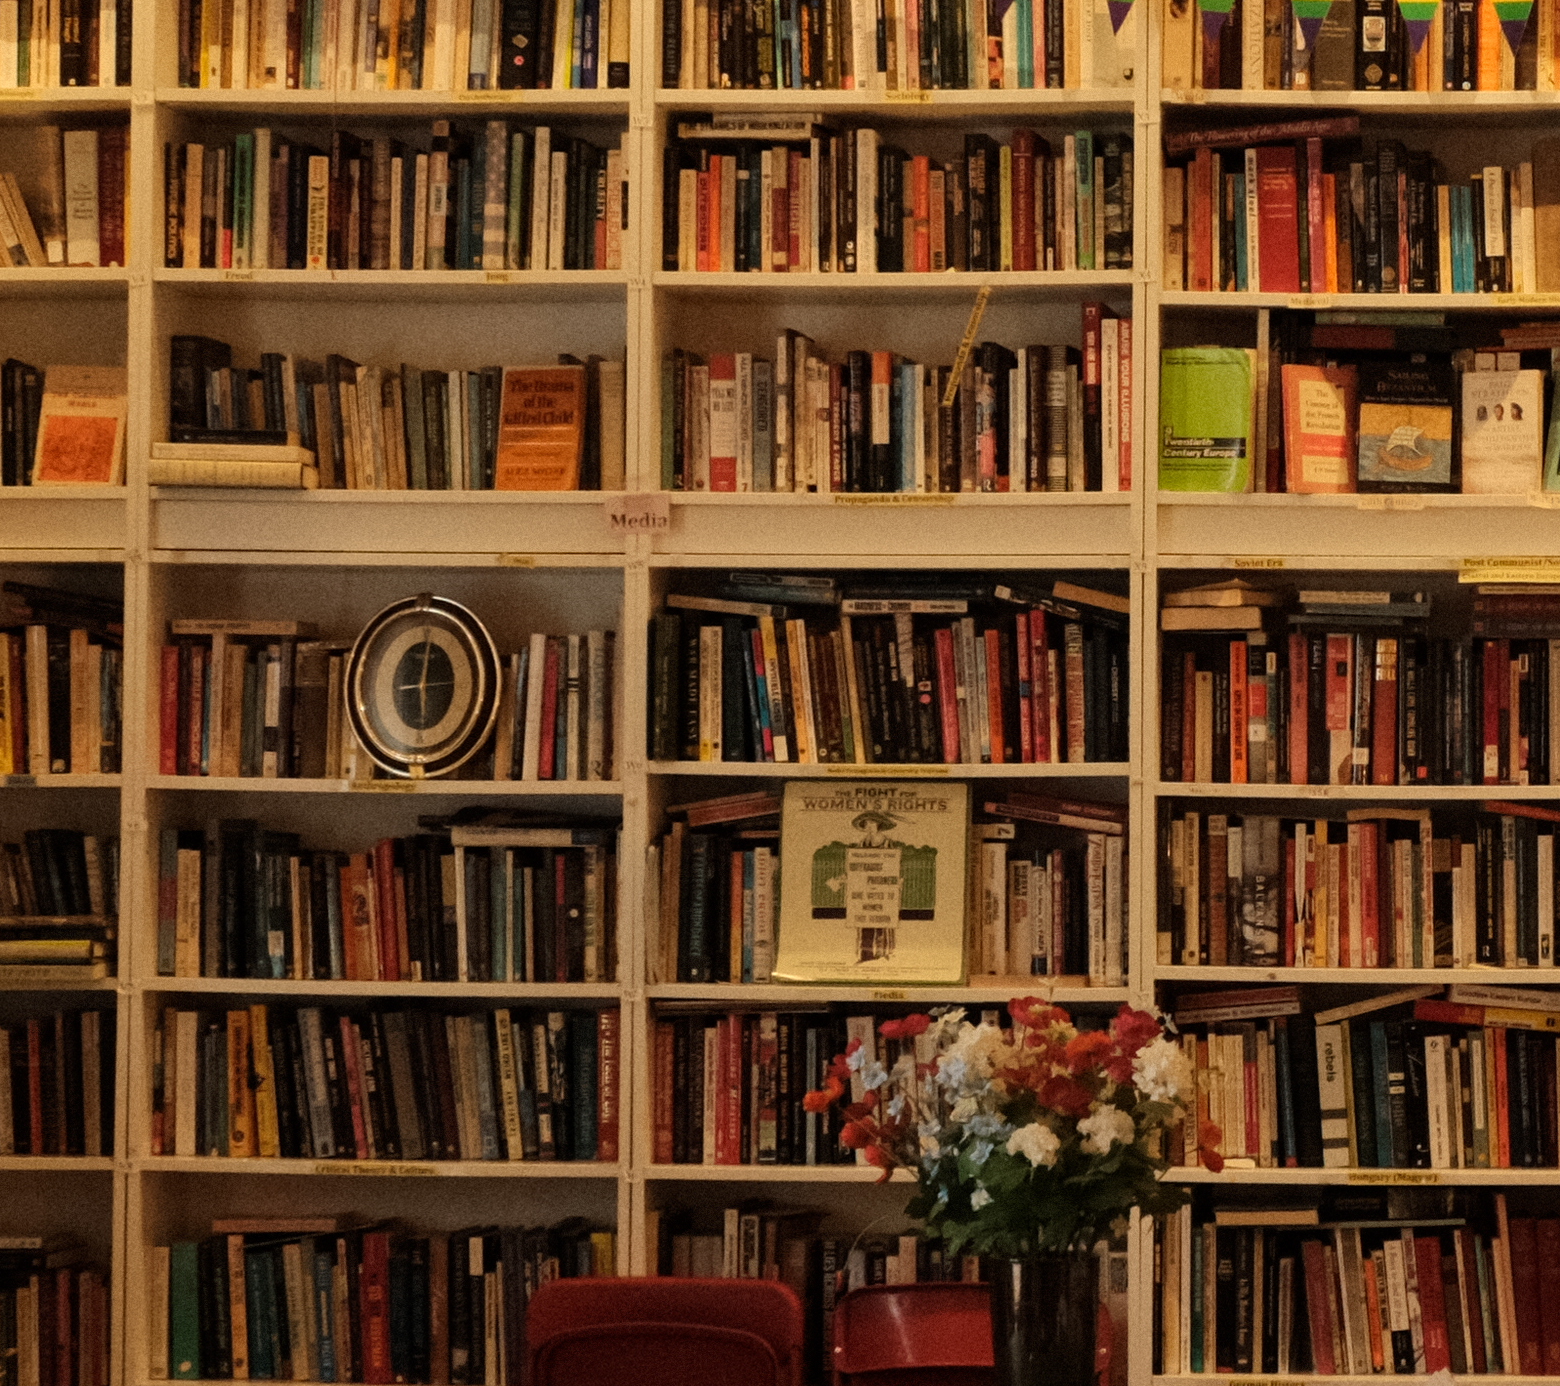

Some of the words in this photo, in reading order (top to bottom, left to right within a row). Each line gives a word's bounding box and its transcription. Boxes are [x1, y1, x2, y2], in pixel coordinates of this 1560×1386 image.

[885, 91, 930, 102] Sociology
[1121, 321, 1130, 356] ABUSE
[1121, 359, 1130, 386] YOUR
[538, 396, 555, 408] the
[1163, 449, 1202, 459] Century
[1203, 449, 1237, 459] Europe
[835, 495, 891, 505] Propaganda
[610, 512, 668, 528] Media
[1234, 558, 1265, 568] Soviet
[1267, 558, 1284, 568] Era
[1463, 557, 1487, 567] Post
[836, 790, 852, 798] THE
[855, 788, 897, 798] FIGHT
[899, 790, 917, 798] FOR
[804, 799, 883, 811] WOMEN'S
[888, 799, 947, 811] RIGHTS
[1324, 1042, 1336, 1082] rebels
